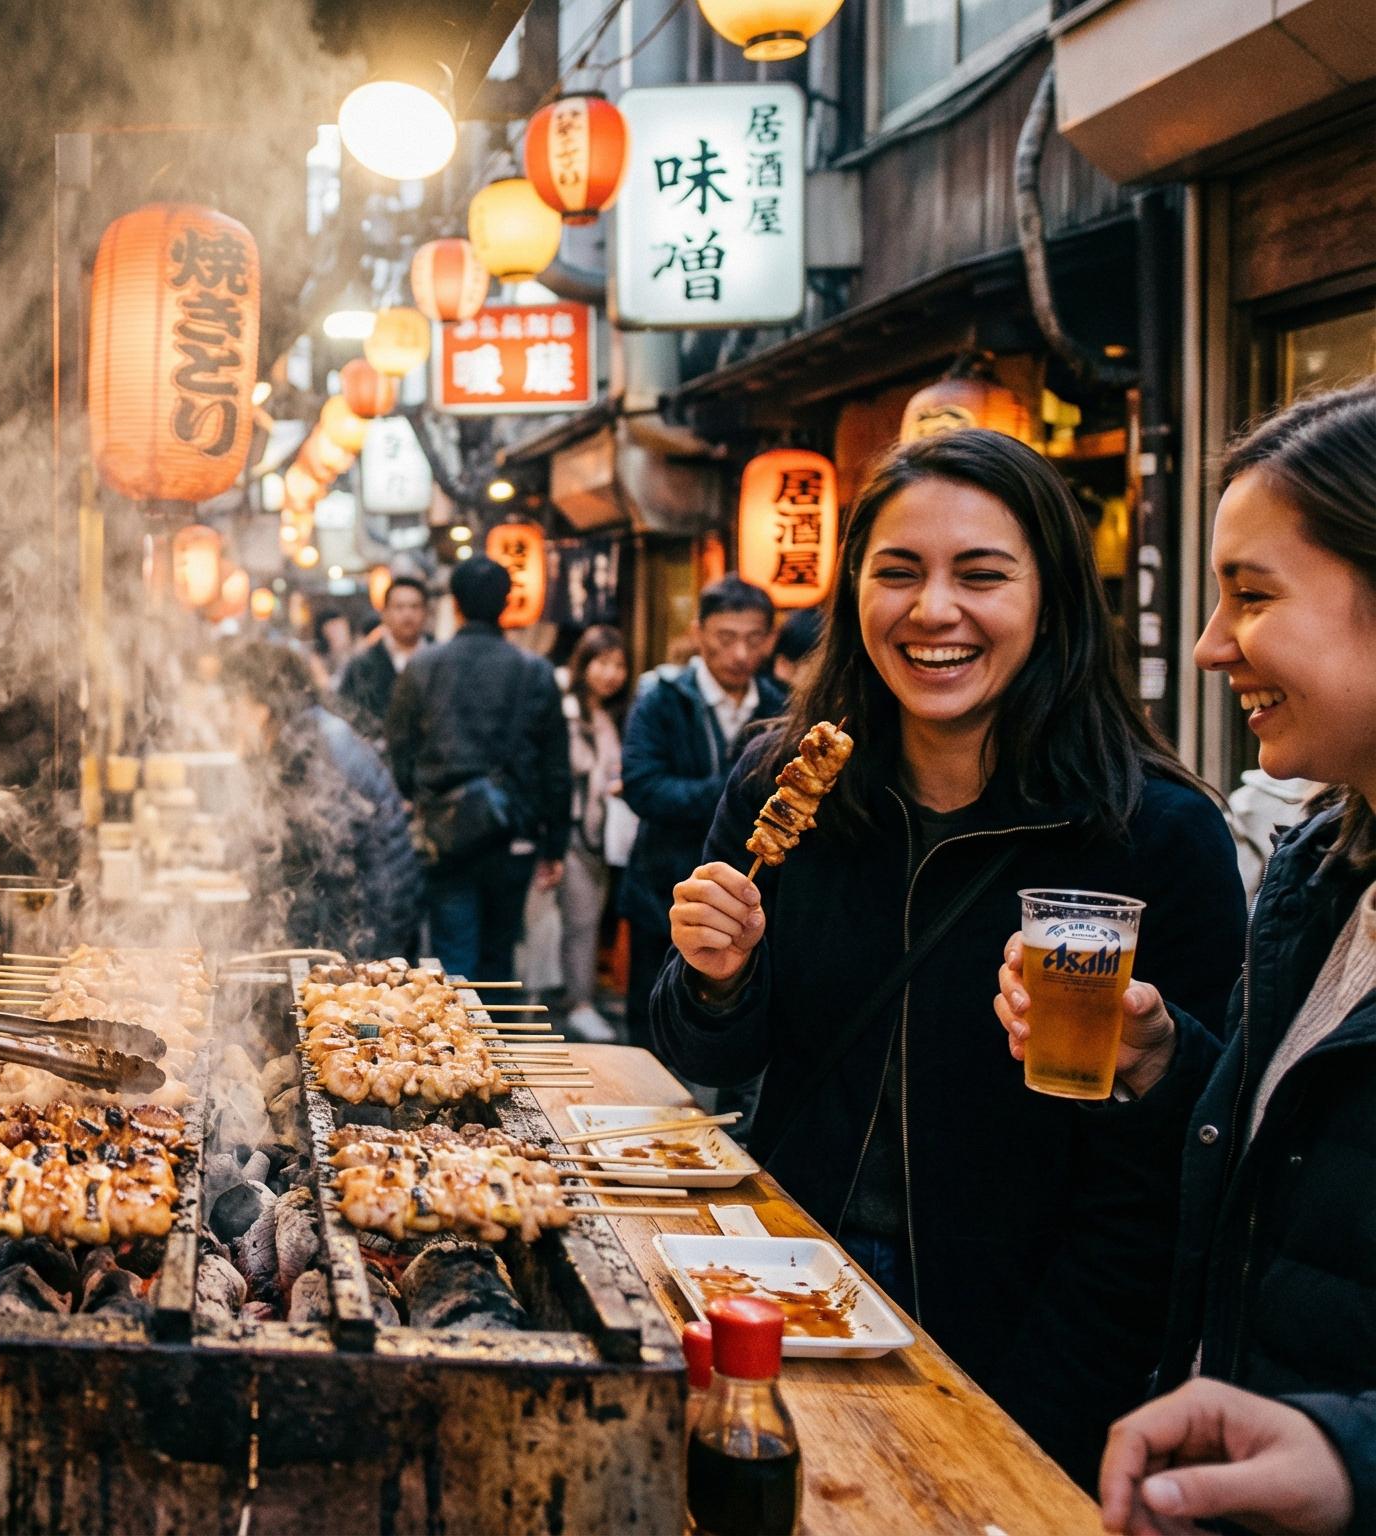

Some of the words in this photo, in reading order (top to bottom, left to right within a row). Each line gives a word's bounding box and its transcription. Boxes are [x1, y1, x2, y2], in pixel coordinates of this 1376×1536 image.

[745, 104, 784, 234] 居酒屋
[772, 469, 821, 588] 居酒屋
[1042, 942, 1121, 976] Asahi
